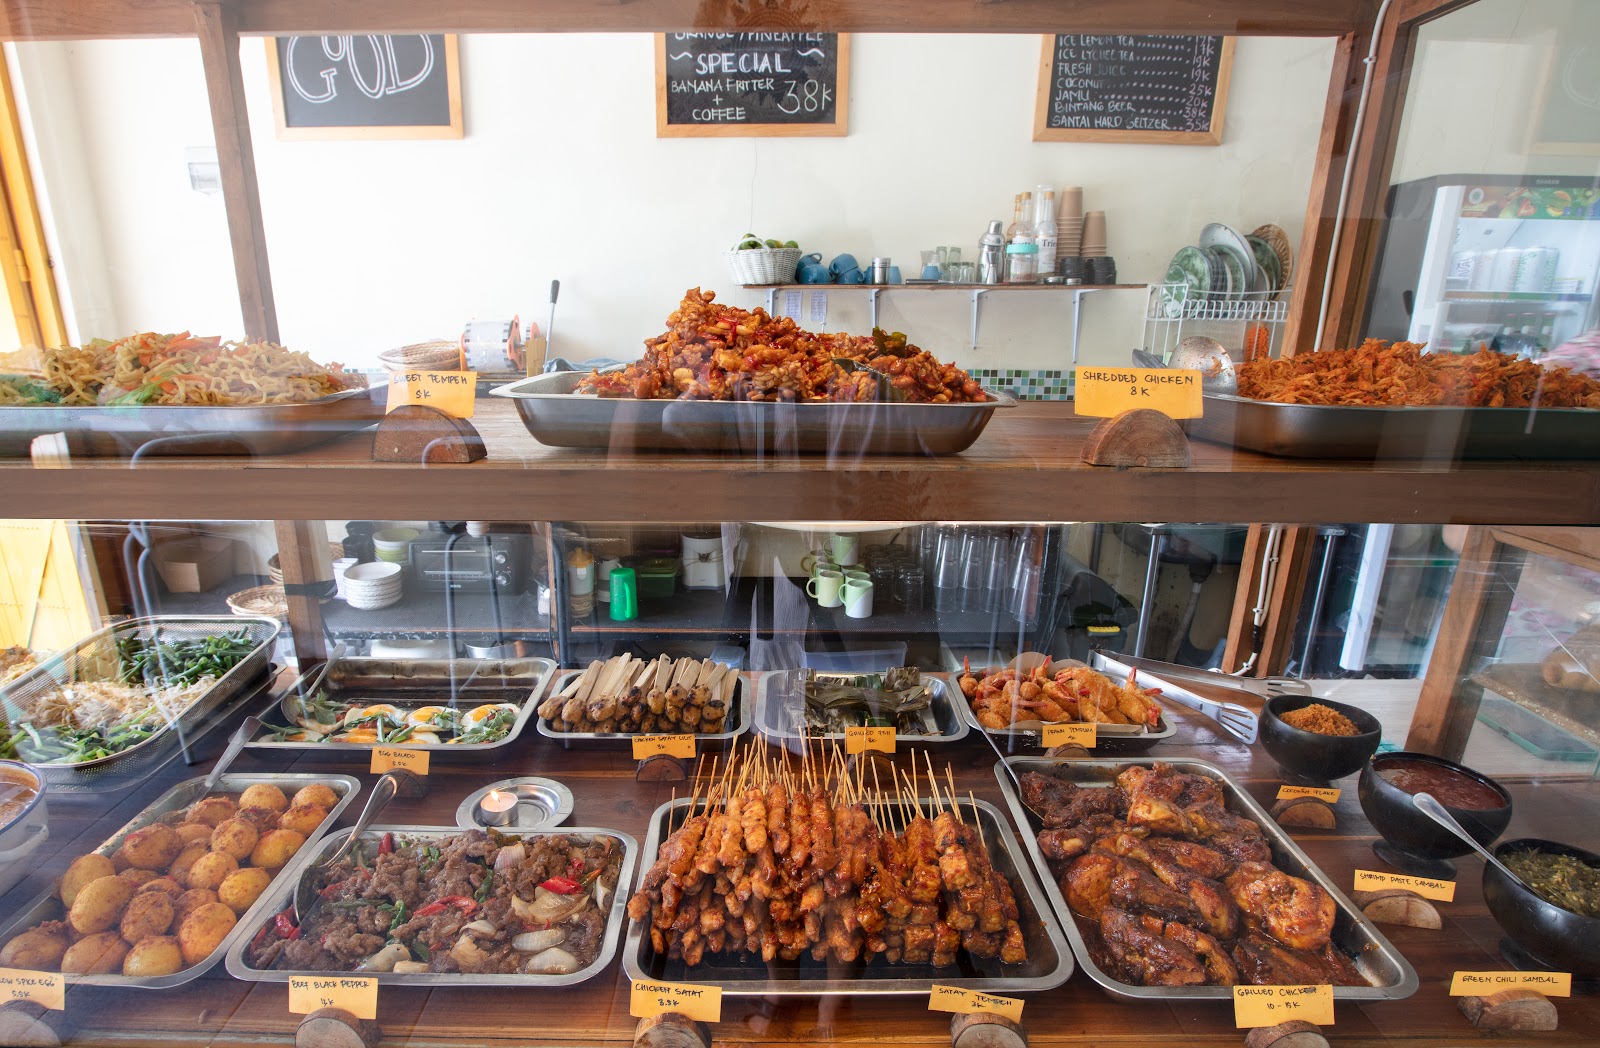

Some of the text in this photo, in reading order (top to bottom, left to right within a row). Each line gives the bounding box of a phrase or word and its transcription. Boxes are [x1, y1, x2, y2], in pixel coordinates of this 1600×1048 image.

[1059, 35, 1075, 47] ICE
[1080, 34, 1113, 47] LEMON
[1117, 35, 1135, 47] TEA
[1058, 48, 1076, 60] ICE
[1081, 49, 1117, 61] LYCHEE
[1118, 50, 1135, 62] TEA
[695, 52, 792, 75] SPECIAL
[1057, 62, 1092, 76] FRESH
[1094, 64, 1126, 76] JUICE
[671, 78, 774, 93] BANANA FRITTER
[1056, 77, 1104, 89] COCONUT
[1055, 90, 1090, 102] JAMU
[1055, 101, 1104, 113] BINTANG
[1108, 101, 1136, 112] BEER
[692, 107, 746, 121] COFFEE
[1052, 115, 1090, 128] SANTAI
[1094, 115, 1122, 127] HARD
[1126, 117, 1171, 130] SELTZER
[394, 373, 468, 385] SWEET TEMPEH
[1083, 370, 1193, 385] SHREDDED CHICKEN
[1359, 872, 1446, 889] SHRIMP PASTE SAMBAL
[291, 979, 370, 990] BEEF BLACK PEPPER
[1462, 975, 1559, 984] GREEN CHILI SAMBAL
[635, 982, 671, 994] CHICKEN
[1237, 988, 1274, 997] GRILLED
[938, 987, 1012, 1006] SATAY TEMPEH
